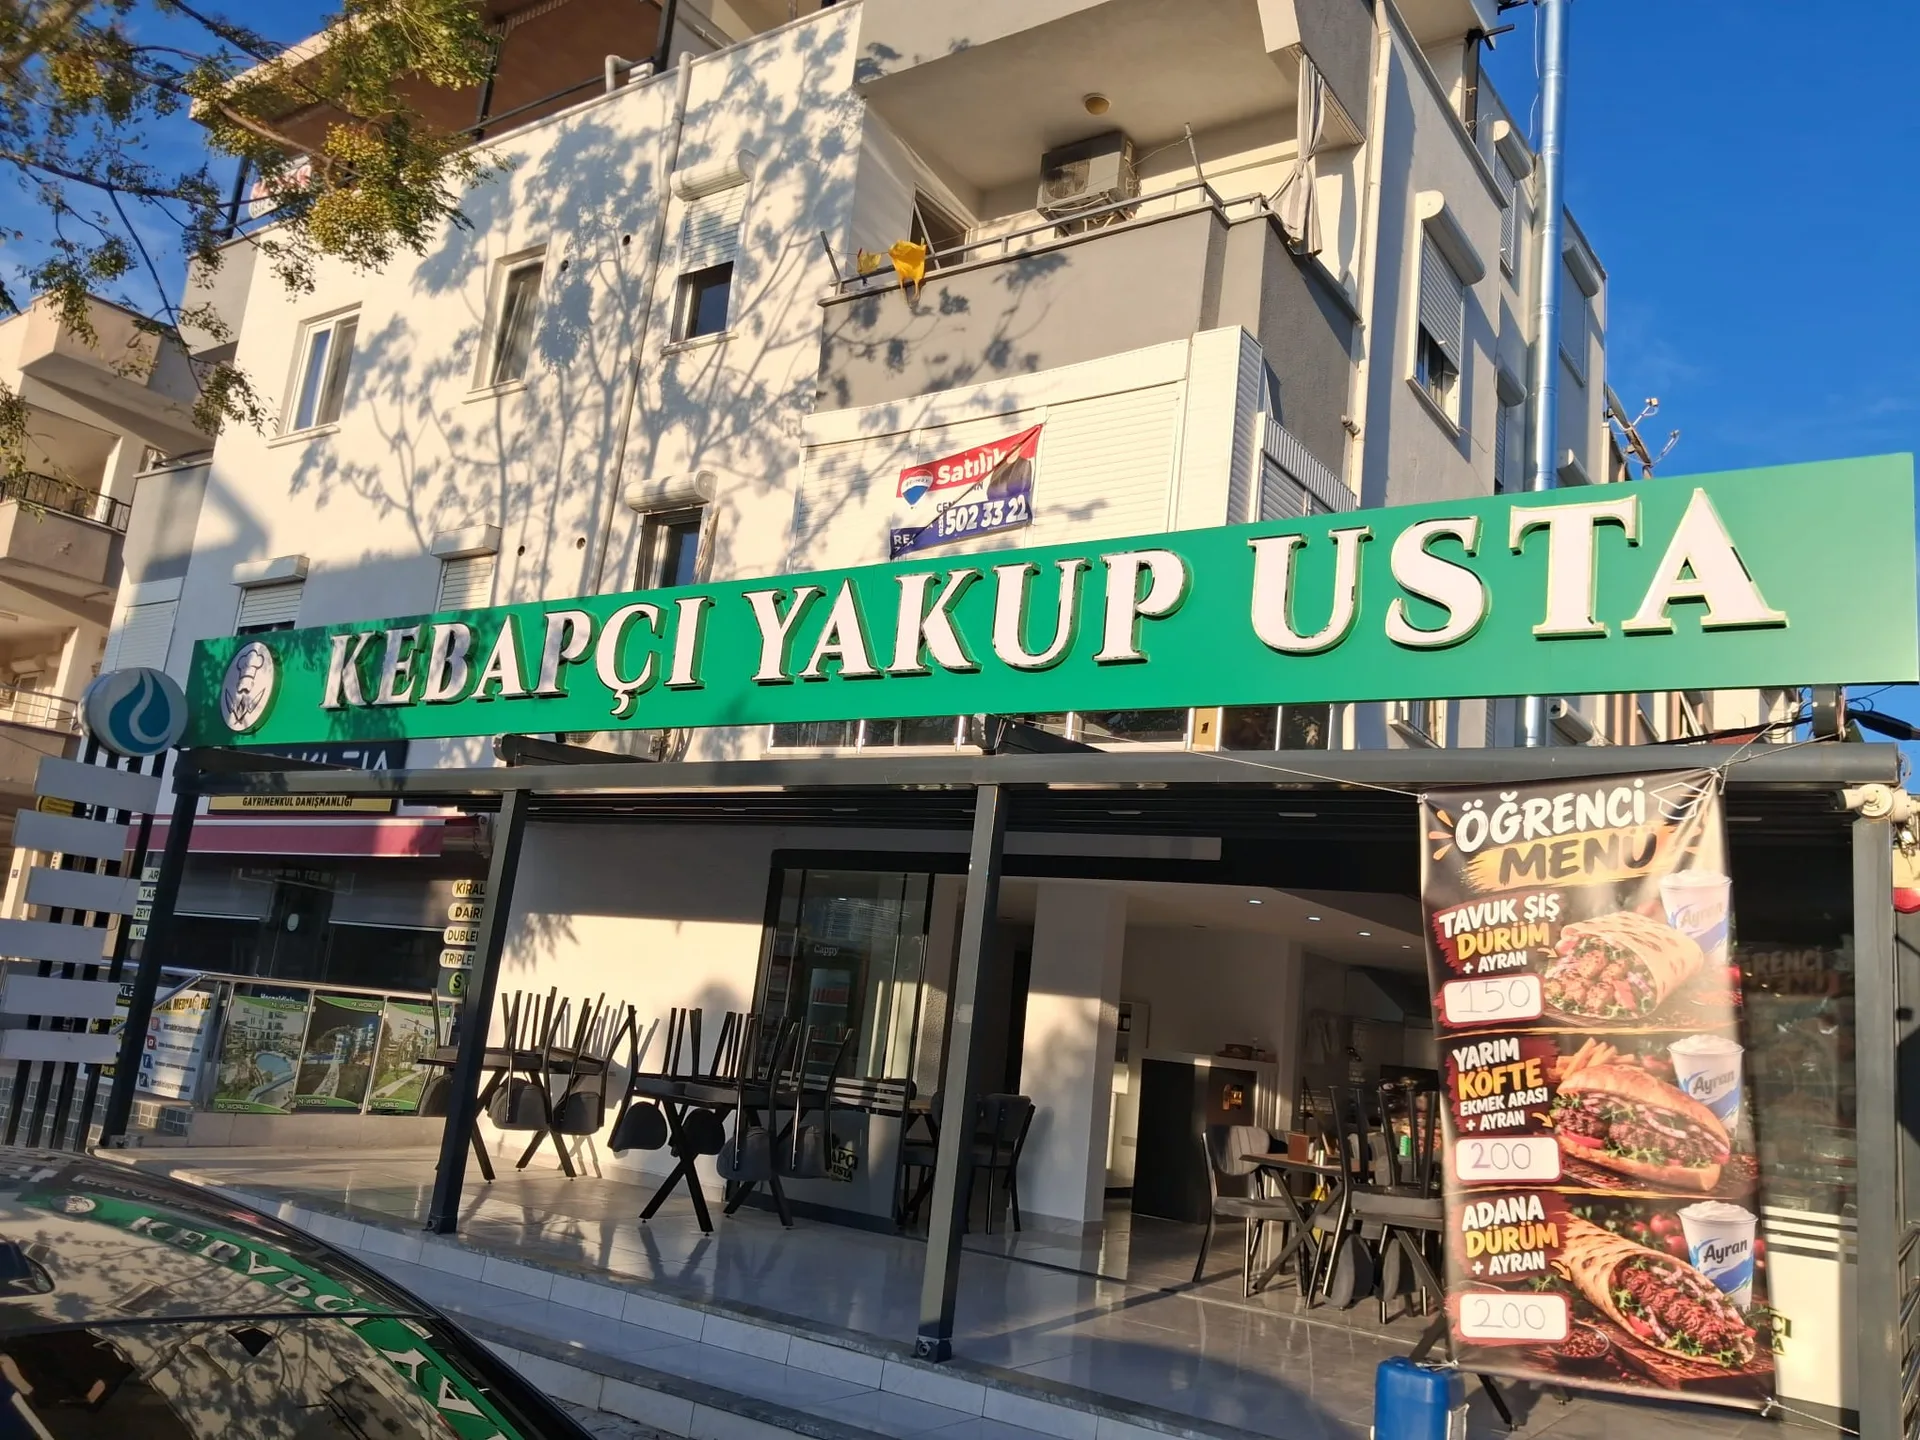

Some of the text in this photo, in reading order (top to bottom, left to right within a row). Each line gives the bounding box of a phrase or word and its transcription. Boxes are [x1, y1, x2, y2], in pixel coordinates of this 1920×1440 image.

[945, 506, 979, 536] 502
[980, 500, 1004, 528] 33
[1006, 494, 1029, 522] 22
[320, 487, 1789, 718] KEBAPÇI YAKUP USTA
[1454, 779, 1646, 853] ÖĞRENCİ
[1497, 827, 1659, 885] MENÜ
[454, 906, 483, 919] DAİR
[1438, 893, 1561, 939] TAVUK ŞİŞ
[447, 930, 478, 942] DUBLE
[813, 944, 840, 957] Cappy
[1456, 923, 1550, 961] DÜRÜM
[444, 952, 474, 966] TRİPLE
[1478, 951, 1527, 972] AYRAN
[1457, 979, 1532, 1014] 150
[1452, 1037, 1520, 1071] YARIM
[1457, 1057, 1543, 1100] KÖFTE
[1692, 1069, 1735, 1096] Ayran
[1459, 1087, 1548, 1117] EKMEK ARASI
[1479, 1110, 1525, 1132] AYRAN
[1471, 1142, 1532, 1170] 200
[1462, 1195, 1544, 1231] ADANA
[1465, 1221, 1559, 1258] DÜRÜM
[1703, 1237, 1748, 1264] Ayran
[1488, 1251, 1545, 1276] AYRAN
[1472, 1299, 1546, 1331] 200
